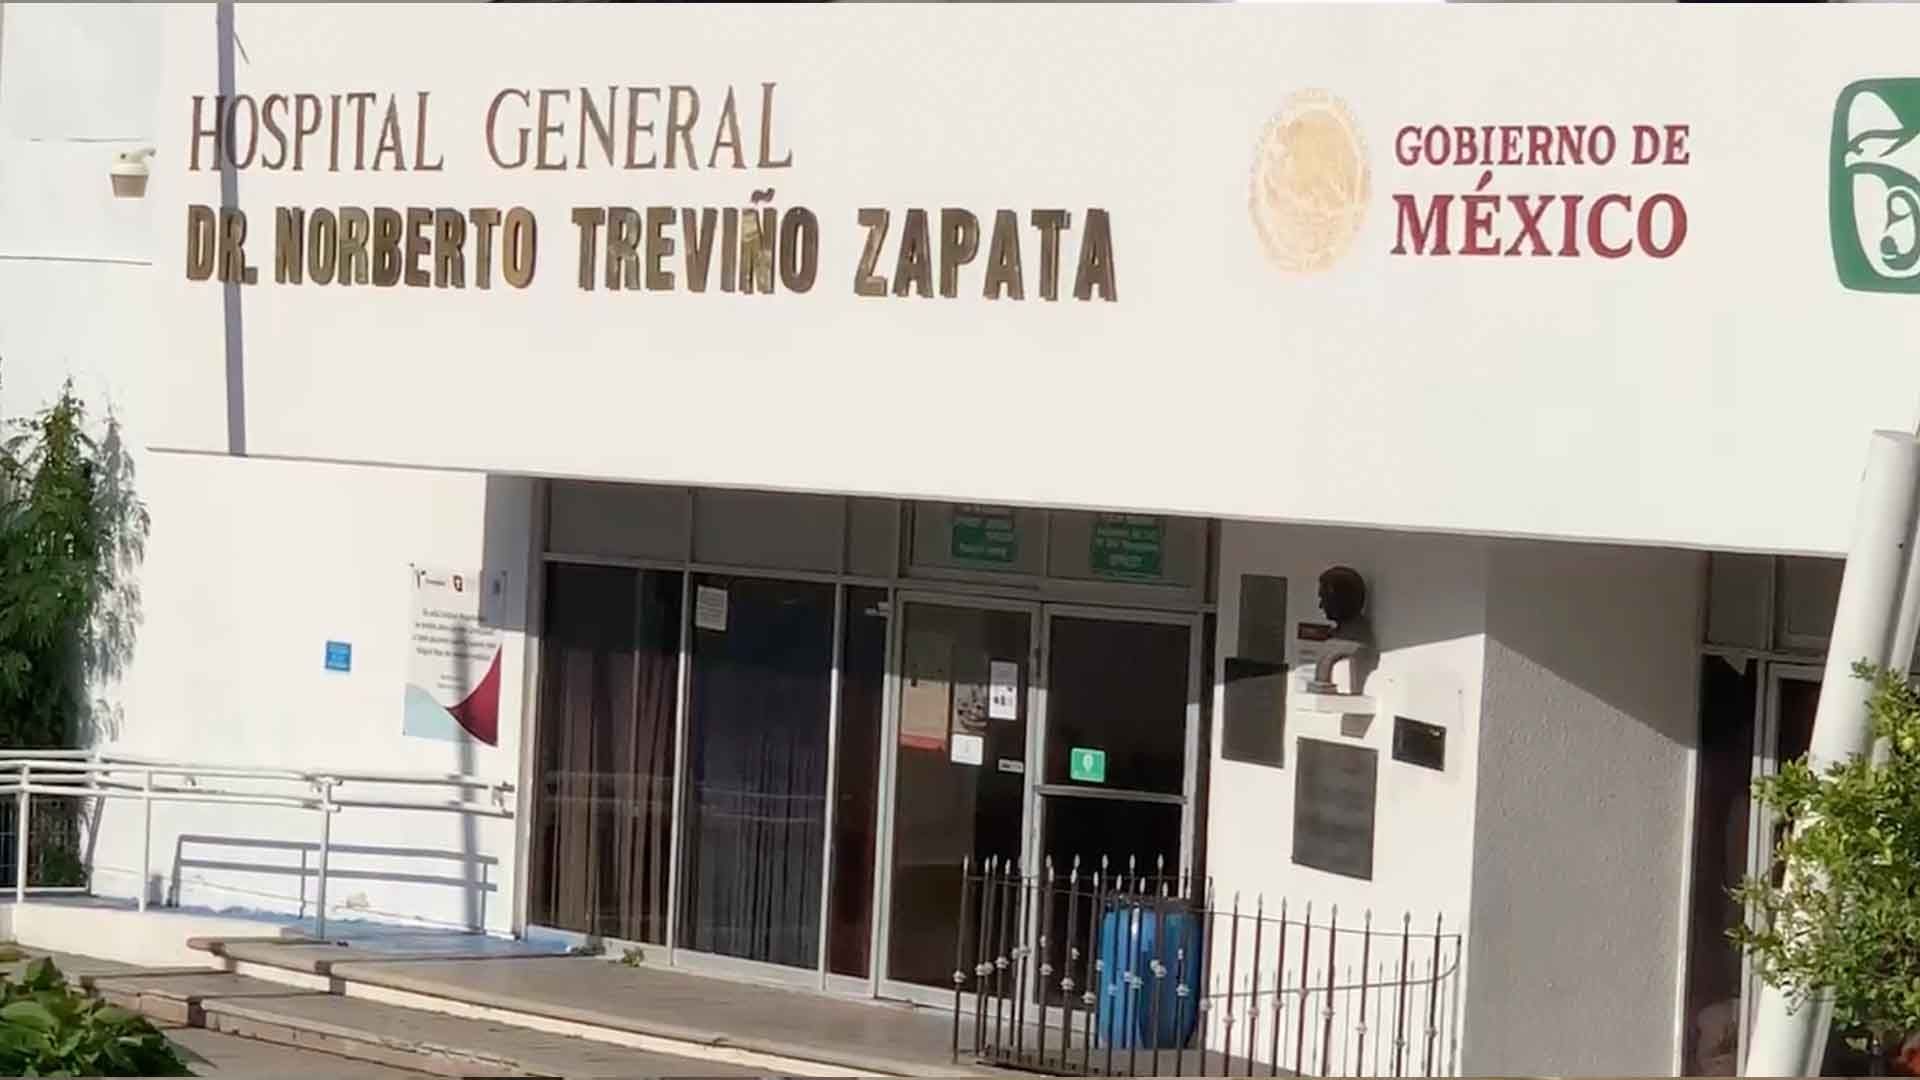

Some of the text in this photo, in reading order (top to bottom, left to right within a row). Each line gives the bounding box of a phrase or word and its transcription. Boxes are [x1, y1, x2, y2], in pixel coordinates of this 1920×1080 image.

[189, 83, 793, 172] HOSPITAL GENERAL
[1396, 125, 1690, 167] GOBIERNO DE
[186, 188, 1117, 302] DR. NORBERTO TREVIÑO ZAPATA
[1390, 170, 1688, 259] MÉXICO
